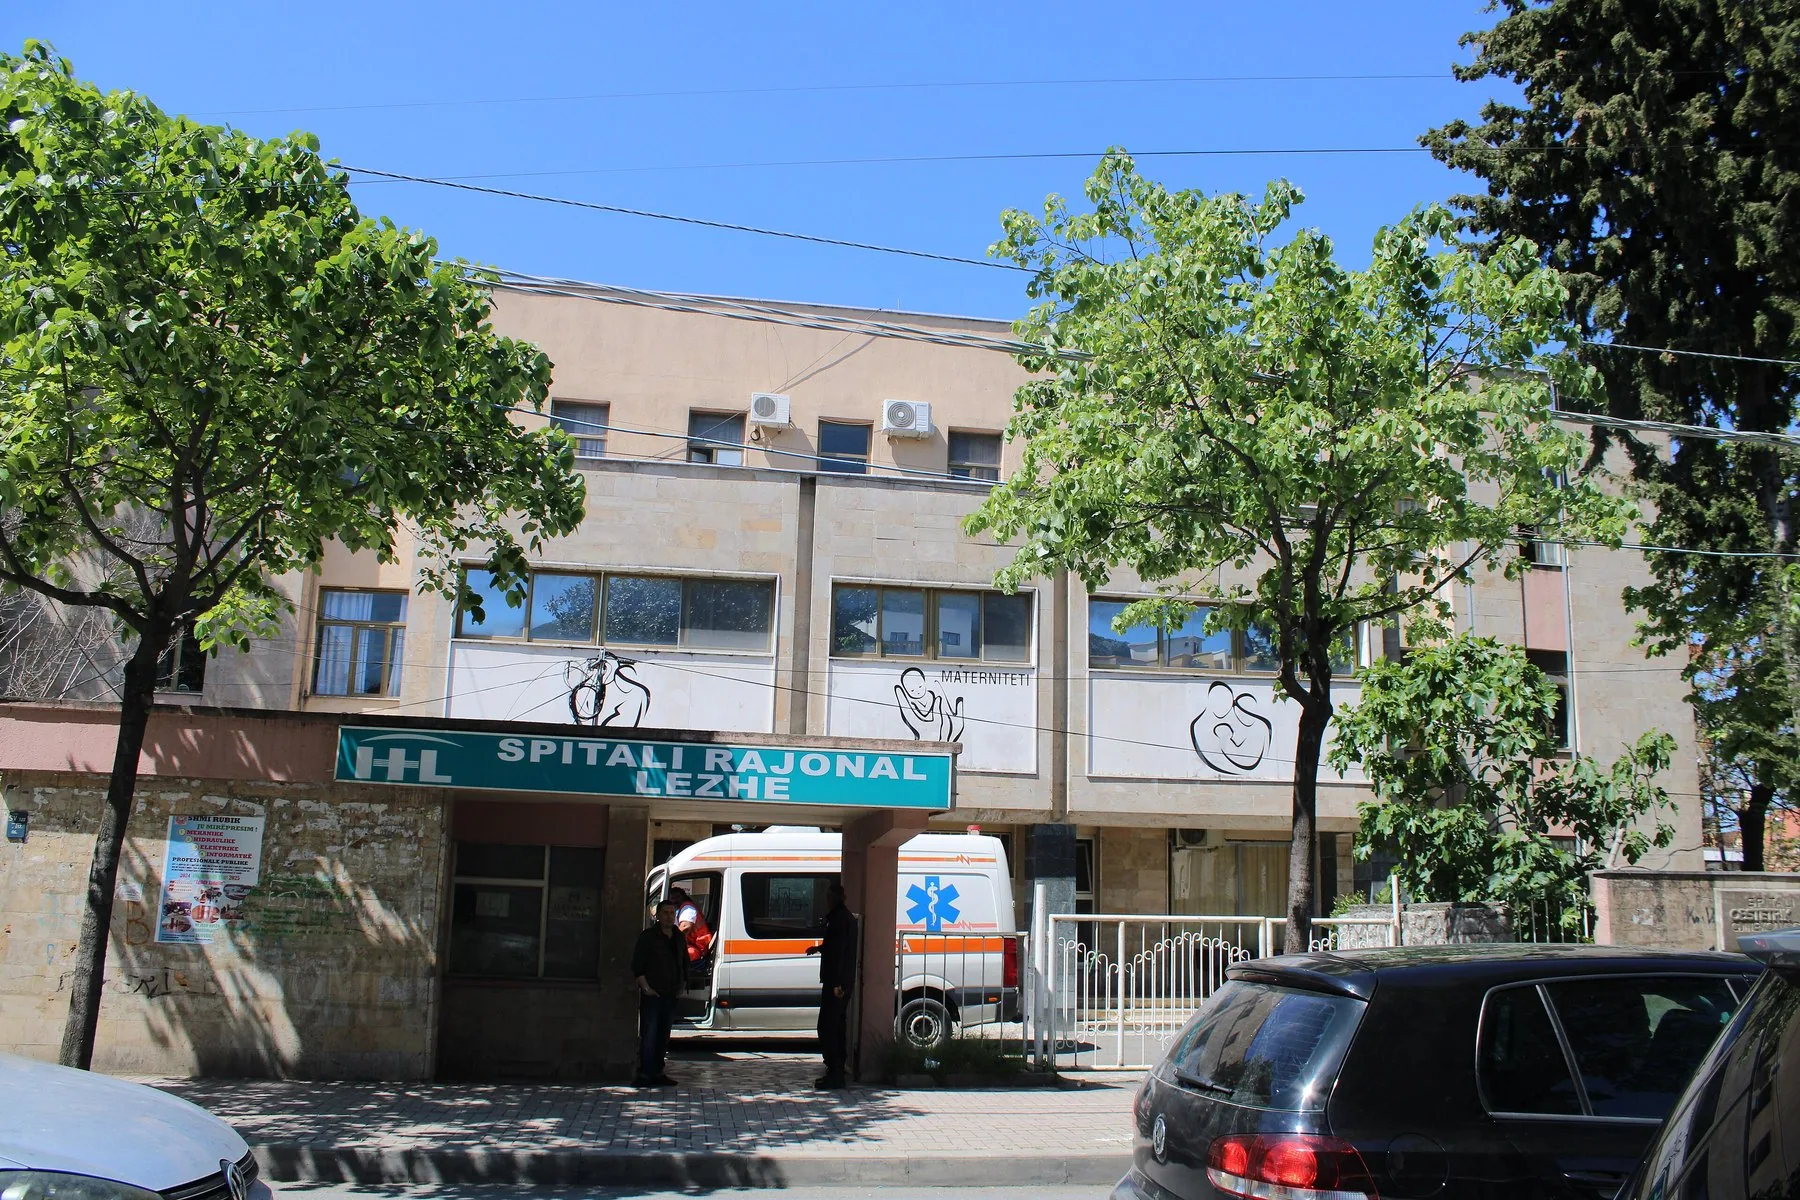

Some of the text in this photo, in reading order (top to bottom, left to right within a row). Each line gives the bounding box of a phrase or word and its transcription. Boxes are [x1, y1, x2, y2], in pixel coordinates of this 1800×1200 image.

[941, 670, 1030, 686] MATERNITETI
[497, 738, 927, 781] SPITALI RAJONAL
[635, 770, 790, 800] LEZHE
[200, 844, 239, 852] ELEKTRIKE
[172, 857, 220, 865] PROFESIONALE
